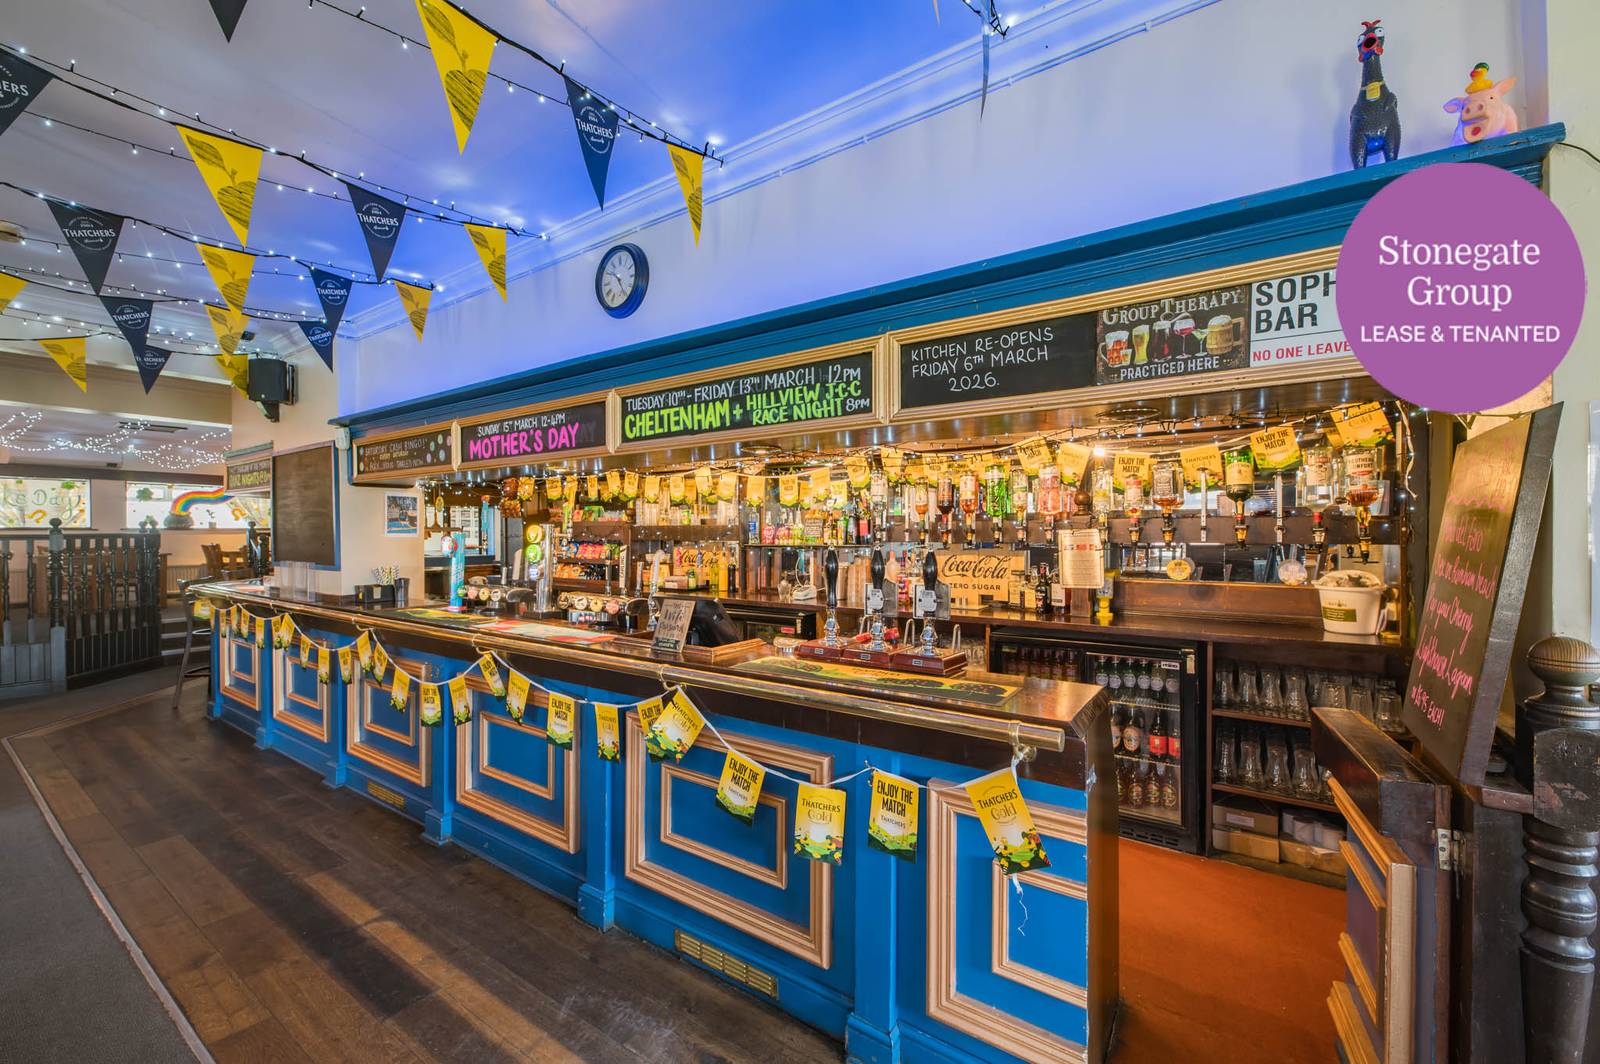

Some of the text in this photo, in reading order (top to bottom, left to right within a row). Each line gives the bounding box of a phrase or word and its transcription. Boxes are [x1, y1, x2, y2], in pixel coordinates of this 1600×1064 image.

[0, 80, 29, 97] ERS
[576, 117, 614, 139] THATCHERS
[357, 212, 399, 226] THATCHERS
[63, 228, 116, 237] THATCHERS
[317, 288, 347, 296] THATCHERS
[113, 311, 150, 321] THATCHERS
[1102, 289, 1242, 325] GROUP THERAPY
[1254, 302, 1318, 334] BAR
[911, 327, 1053, 362] KITCHEN RE-OPENS
[1252, 349, 1271, 362] NO
[1275, 346, 1302, 359] ONE
[912, 345, 1048, 378] FRIDAY 6TH MARCH
[1120, 356, 1220, 381] PRACTICED HERE
[626, 397, 664, 411] TUESDAY
[694, 380, 735, 403] FRIDAY
[764, 366, 815, 390] MARCH
[625, 398, 730, 439] CHELTENHAM
[733, 403, 743, 420] +
[746, 383, 820, 411] HILLVIEW
[752, 397, 870, 426] RACE NIGHT 8PM
[478, 424, 500, 437] SUNDAY
[514, 416, 537, 431] MARCH
[1256, 429, 1289, 444] ENJOY THE
[469, 422, 579, 460] MOTHER'S DAY
[1264, 439, 1286, 450] MATCH
[1118, 457, 1145, 465] ENJOY THE
[1122, 465, 1140, 473] MATCH
[1445, 648, 1473, 700] Lagoon
[554, 709, 568, 721] MATCH
[728, 757, 759, 785] ENJOY THE
[730, 772, 752, 793] MATCH
[877, 780, 913, 805] ENJOY THE
[802, 798, 840, 813] THATCHERS
[881, 797, 906, 818] MATCH
[976, 788, 1018, 810] THATCHERS
[807, 809, 832, 822] Gold
[990, 804, 1018, 821] Gold
